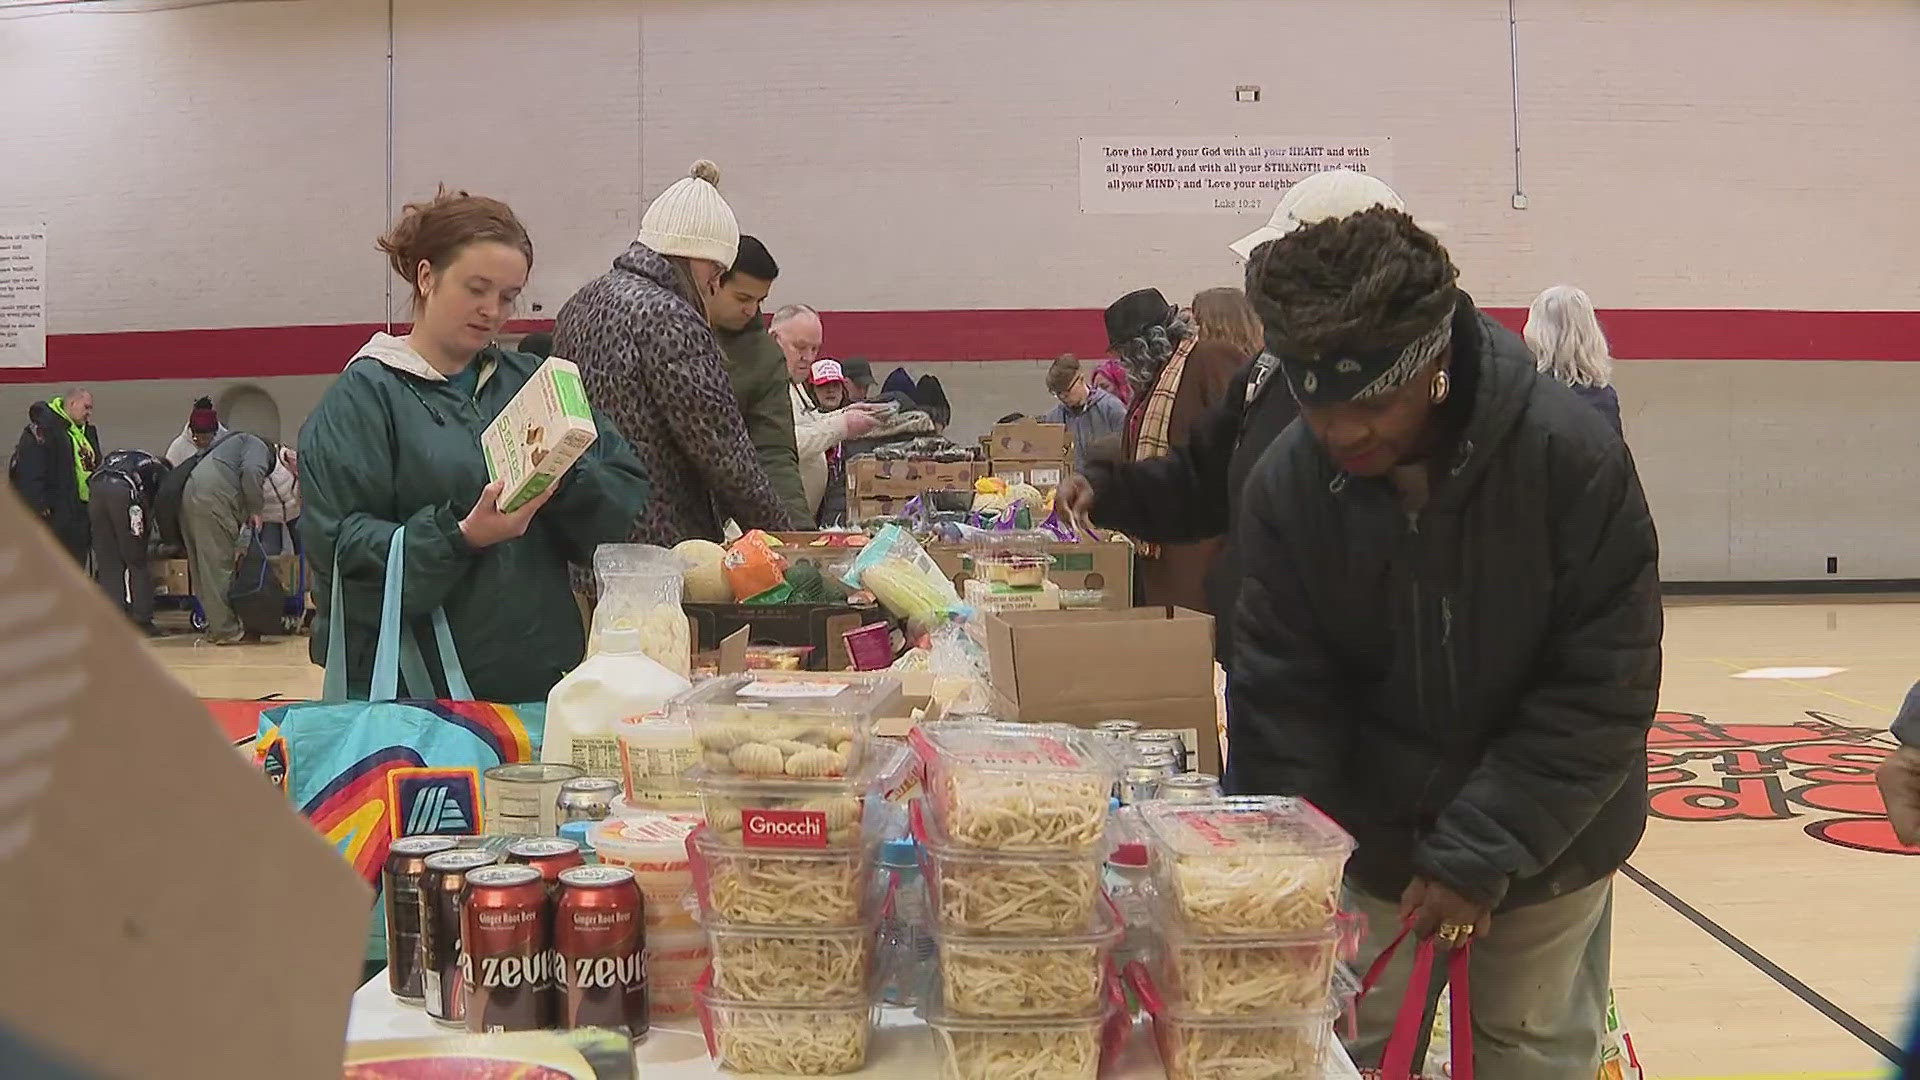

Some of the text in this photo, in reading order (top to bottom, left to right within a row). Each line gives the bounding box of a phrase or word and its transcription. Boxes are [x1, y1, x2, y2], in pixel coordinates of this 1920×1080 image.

[1132, 147, 1148, 157] the
[1151, 147, 1174, 157] Lord
[1176, 148, 1199, 159] your
[1201, 147, 1221, 157] God
[1223, 147, 1246, 157] with
[1248, 147, 1261, 157] all
[1263, 148, 1286, 158] your
[1289, 147, 1324, 157] HEART
[1326, 147, 1345, 157] and
[1347, 147, 1370, 157] with
[1106, 163, 1119, 173] all
[1121, 164, 1144, 175] your
[1146, 163, 1176, 173] SOUL
[1178, 163, 1196, 173] and
[1198, 163, 1221, 173] with
[1223, 163, 1237, 173] all
[1239, 164, 1261, 174] your
[1264, 163, 1321, 173] STRENGTH
[1107, 179, 1120, 189] all
[1121, 181, 1143, 192] your
[1183, 179, 1202, 189] and
[1233, 181, 1256, 191] your
[1214, 199, 1262, 208] Luke 10:27
[749, 816, 820, 835] Gnocchi
[479, 911, 536, 926] Ginger Root Beer
[573, 911, 631, 926] Ginger Root Beer
